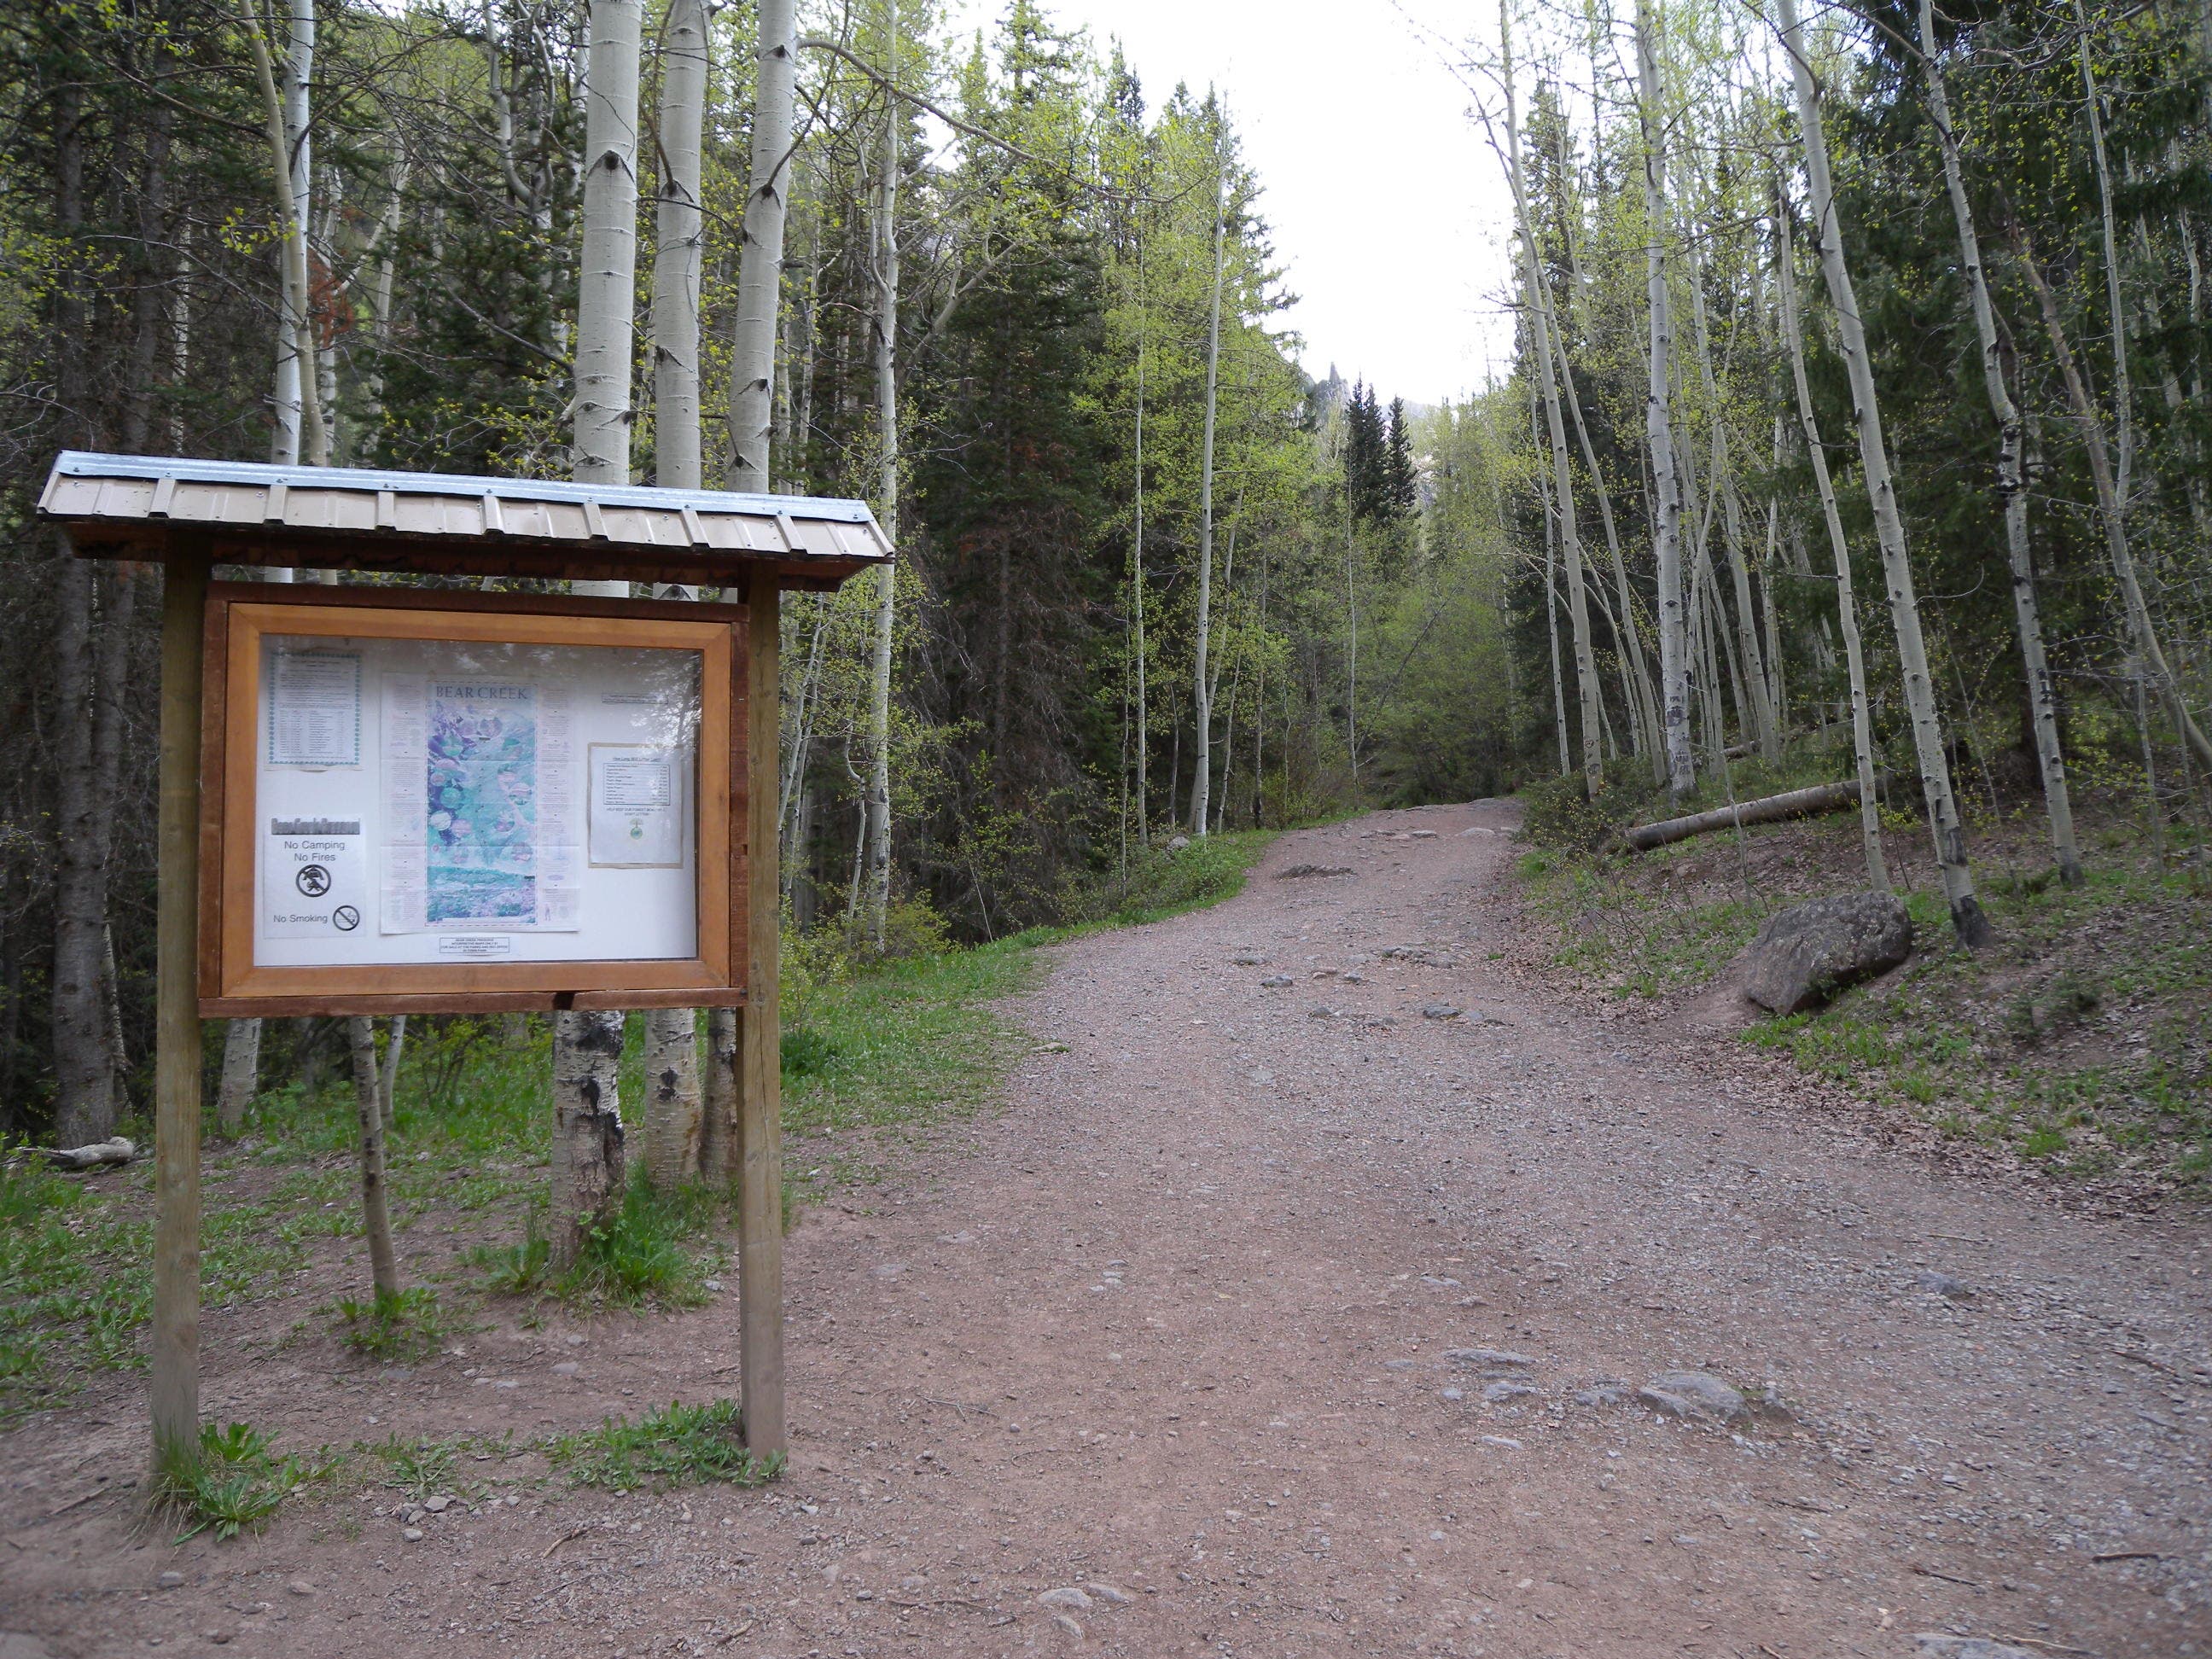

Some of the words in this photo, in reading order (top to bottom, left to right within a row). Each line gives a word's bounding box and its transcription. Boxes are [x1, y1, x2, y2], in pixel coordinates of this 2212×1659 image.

[436, 686, 474, 698] BEAR
[478, 687, 527, 699] CREEK
[284, 841, 299, 849] No
[301, 840, 345, 851] Camping
[294, 853, 308, 861] No
[311, 853, 336, 861] Fires
[273, 914, 287, 923] No
[289, 914, 328, 924] Smoking
